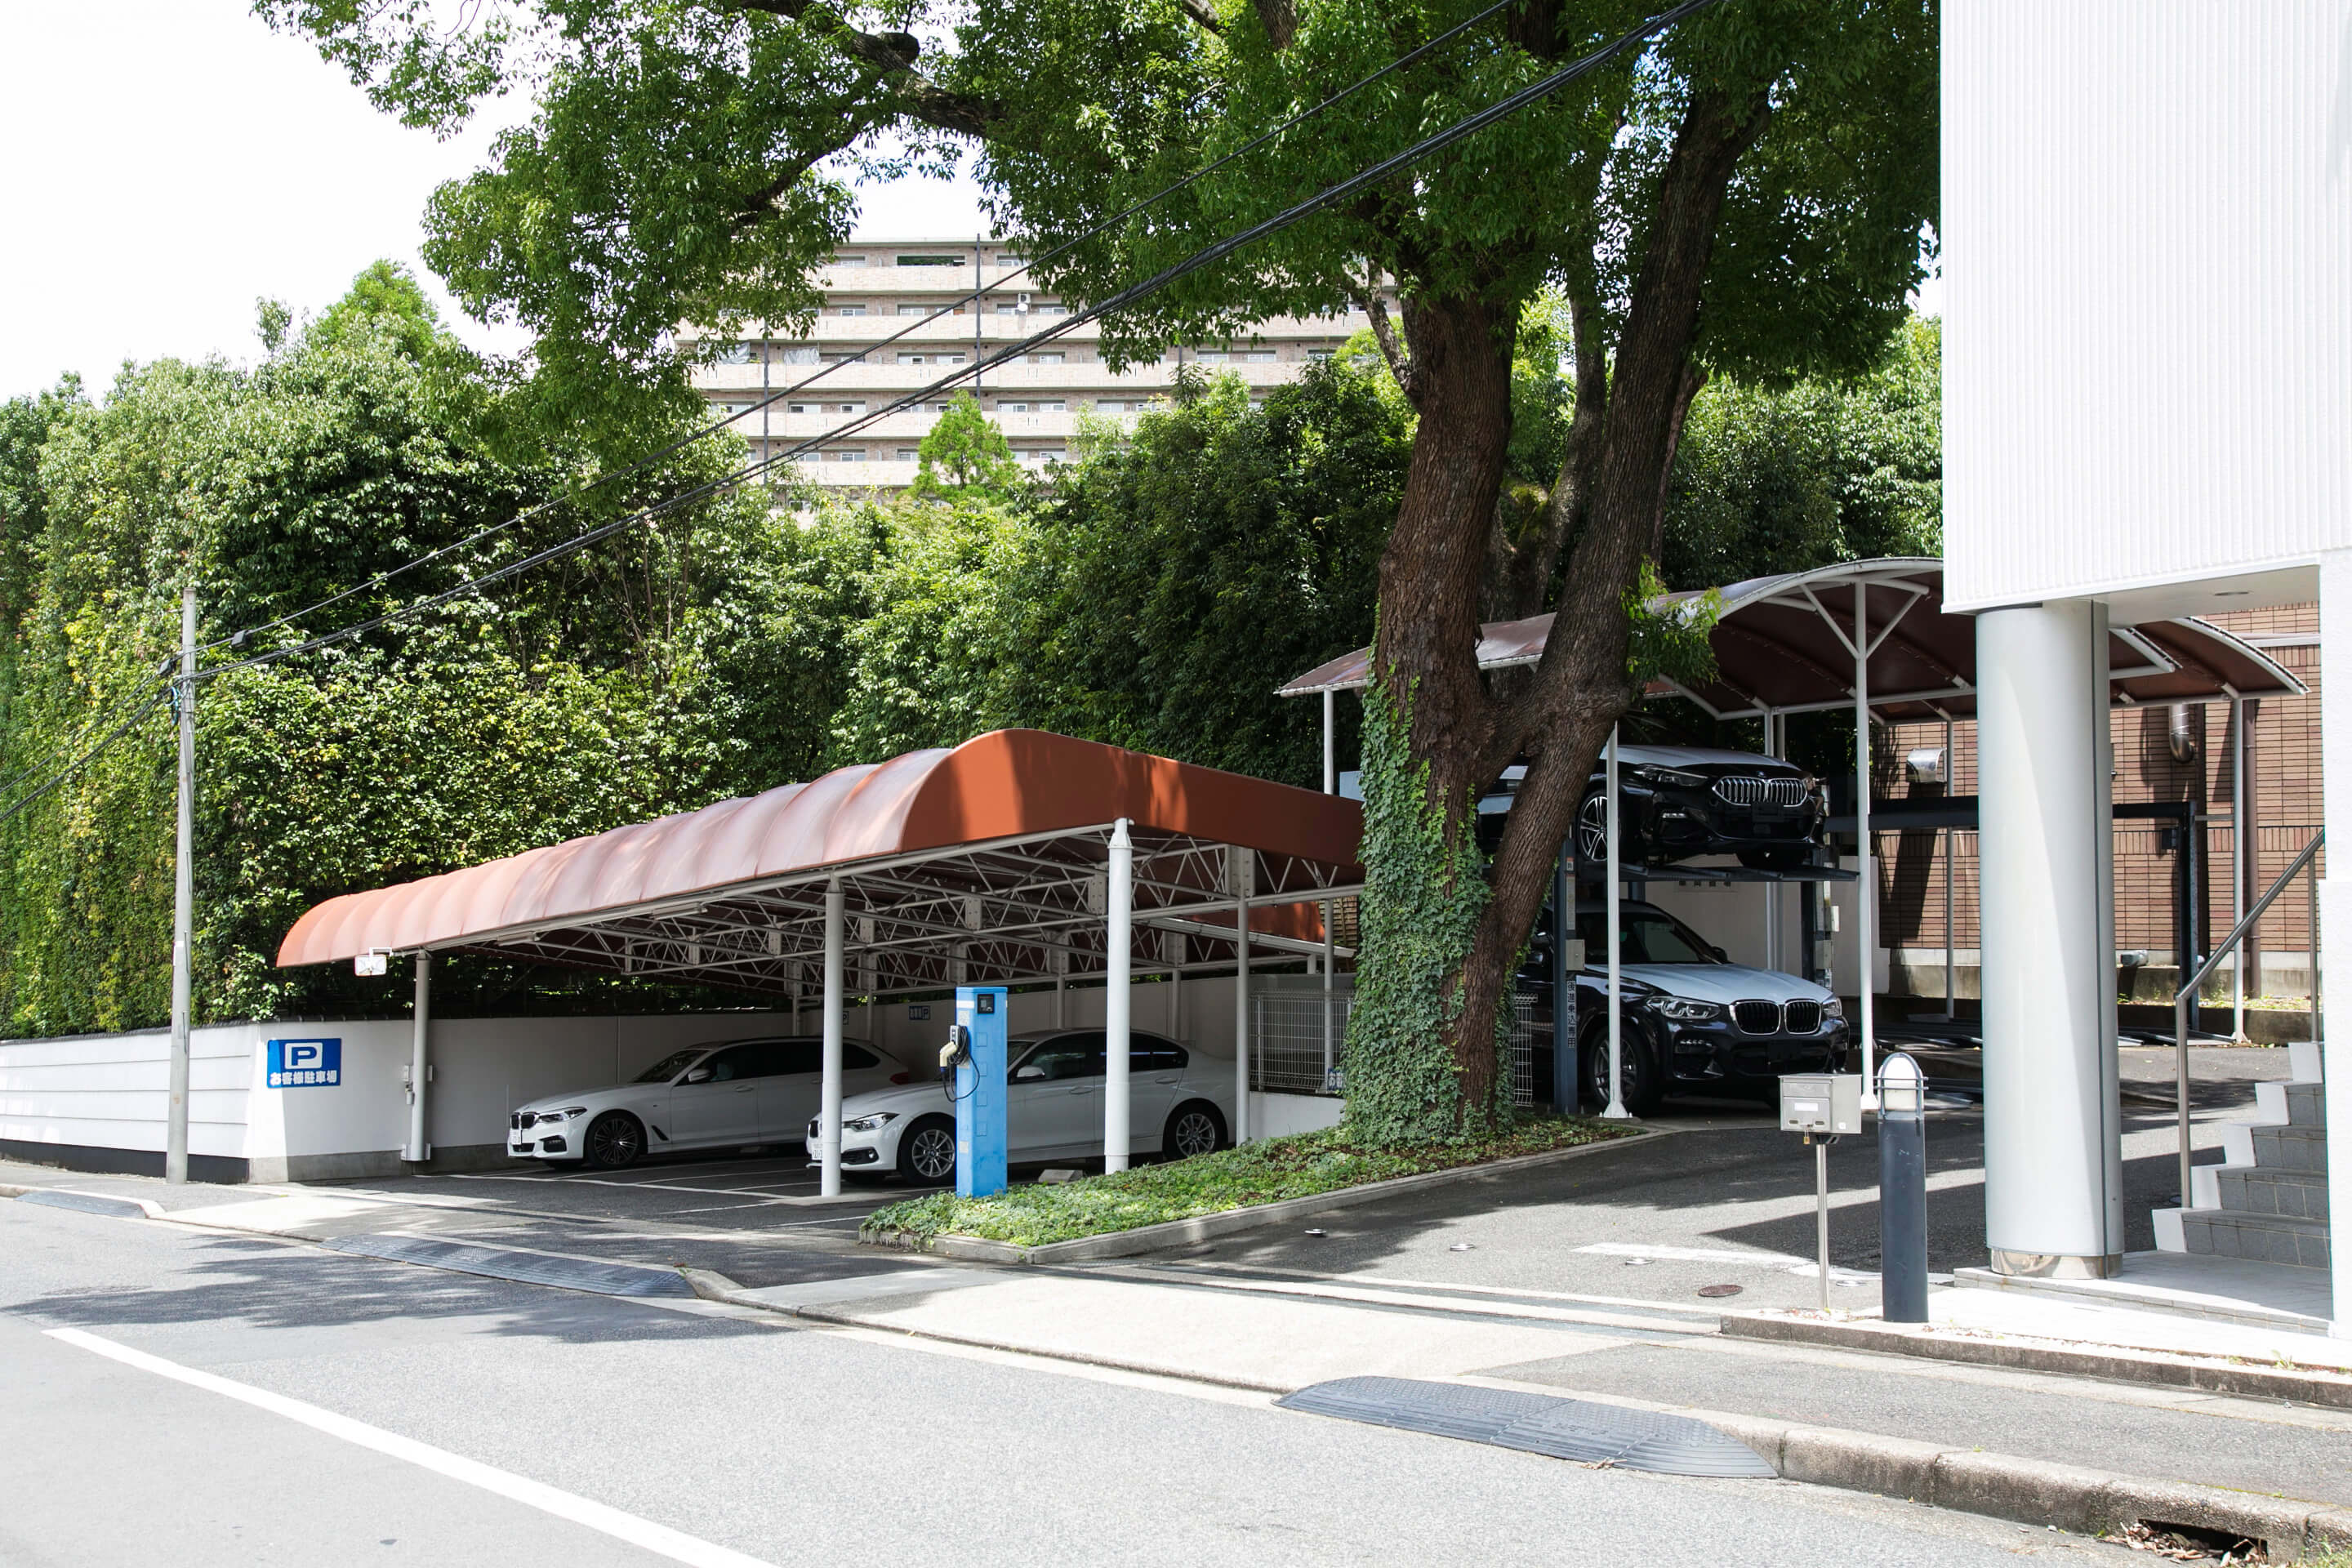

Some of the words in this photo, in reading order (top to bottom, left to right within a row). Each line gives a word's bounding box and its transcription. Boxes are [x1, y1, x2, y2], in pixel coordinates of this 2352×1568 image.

[292, 1047, 317, 1066] P
[270, 1070, 337, 1085] お客様駐車場
